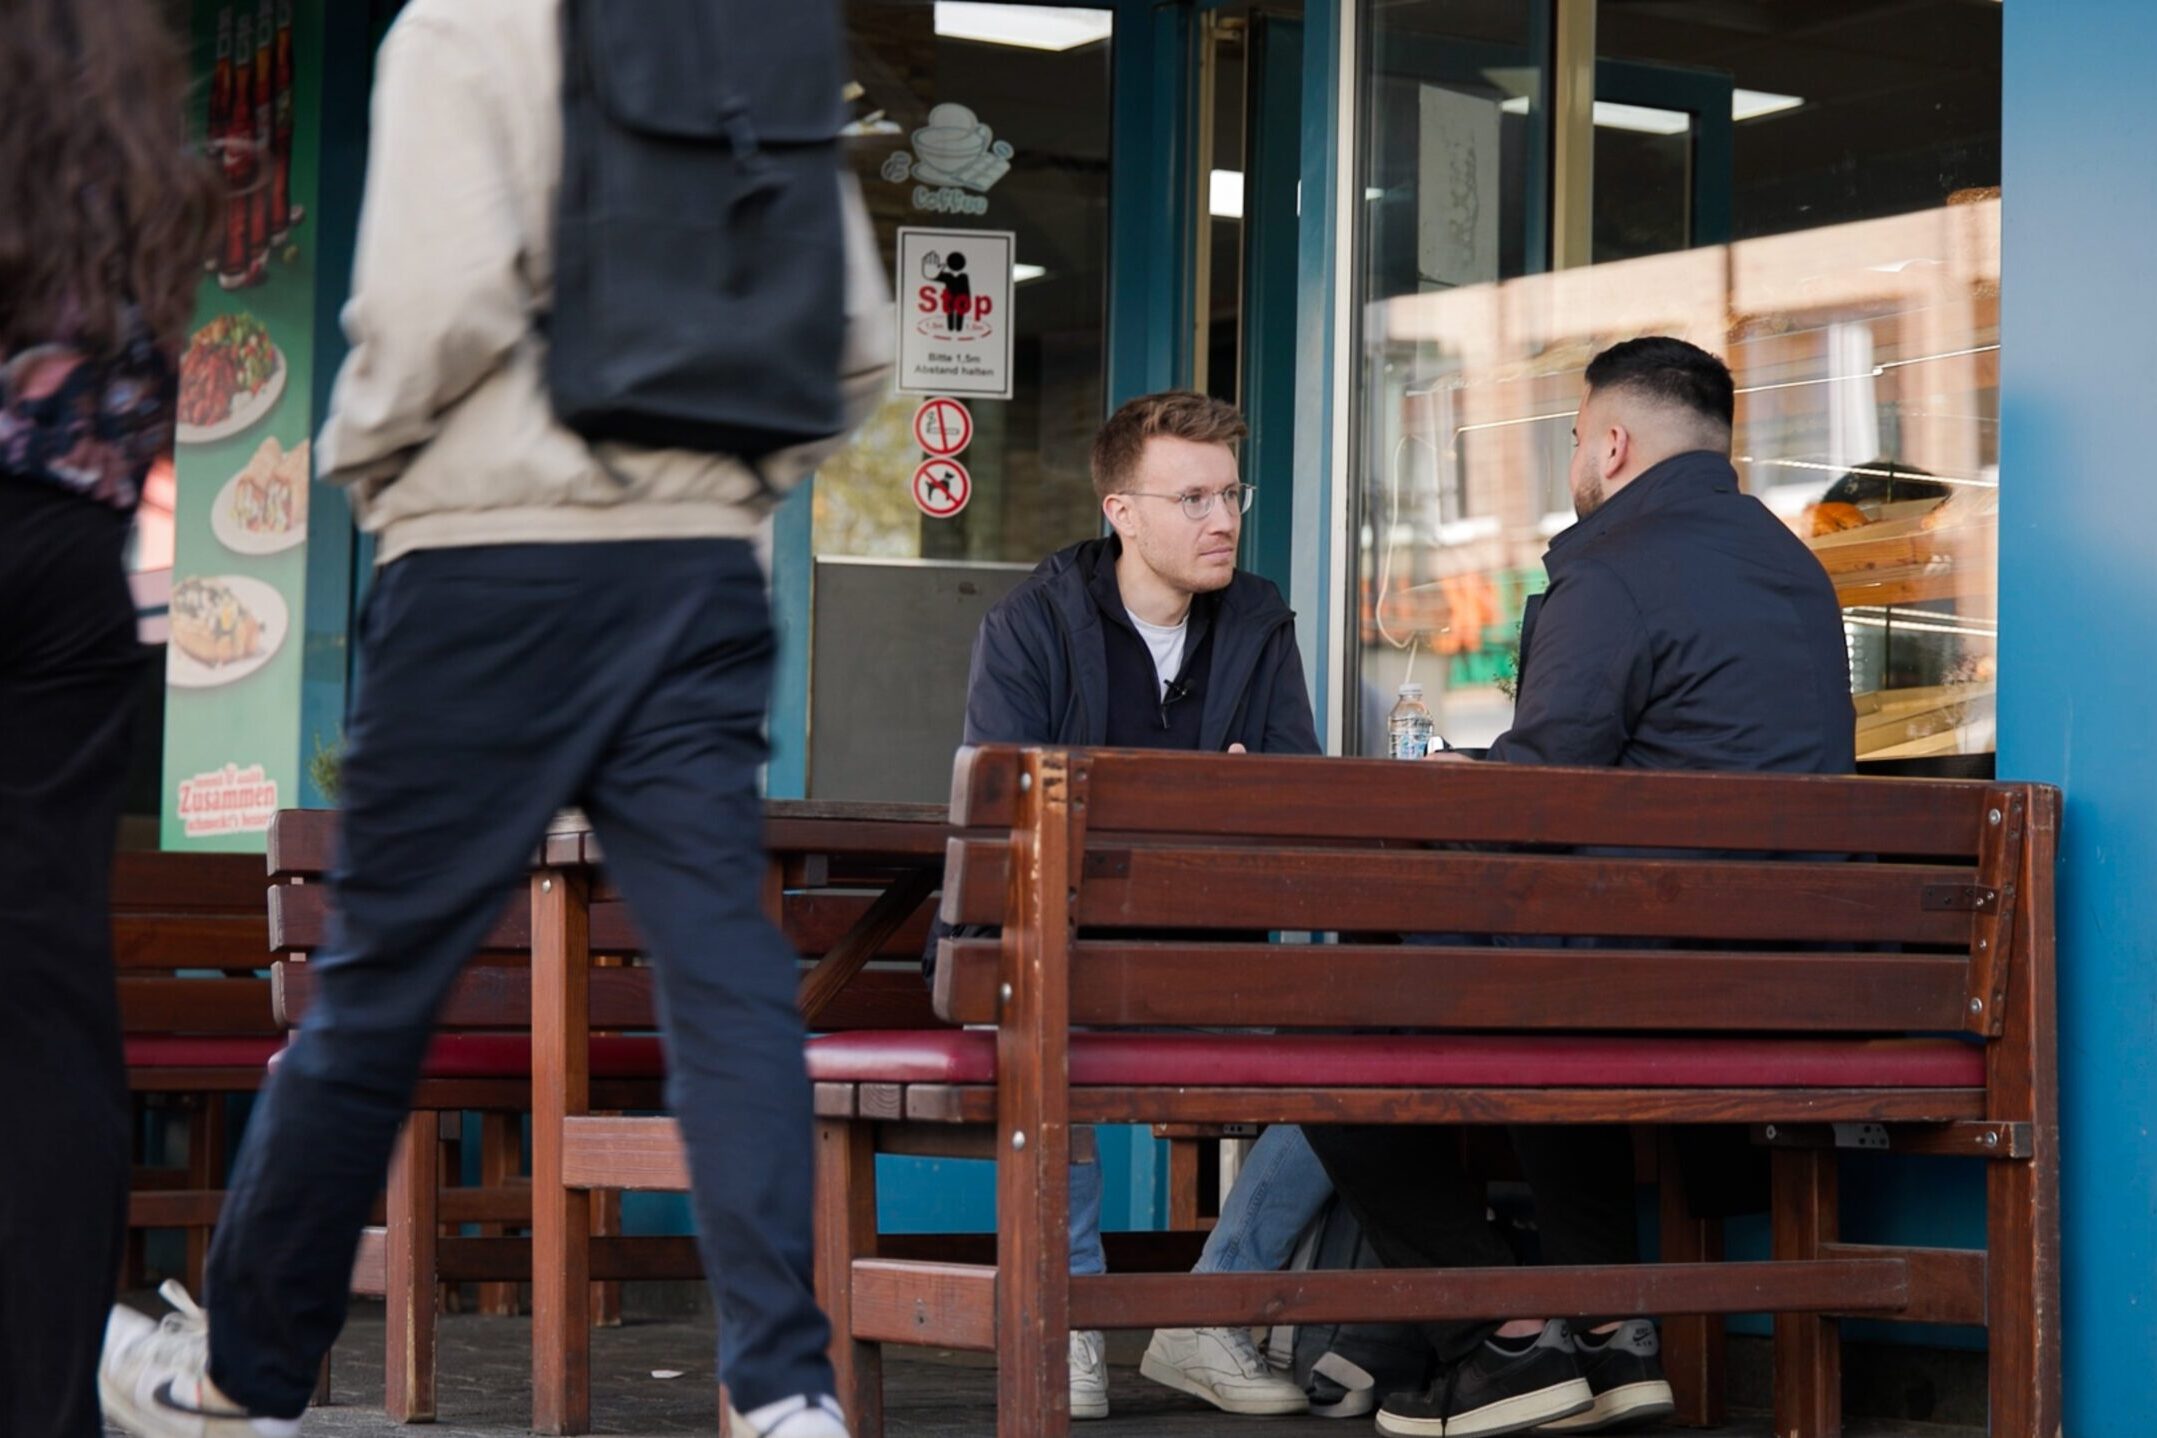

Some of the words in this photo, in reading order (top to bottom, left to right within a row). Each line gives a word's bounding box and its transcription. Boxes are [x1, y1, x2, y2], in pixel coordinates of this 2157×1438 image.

[913, 186, 987, 215] Coffee
[918, 285, 993, 322] Stop
[914, 364, 959, 375] Abstand
[961, 366, 994, 376] halten
[928, 352, 952, 362] Bitte
[956, 353, 981, 363] 1,5m
[180, 785, 275, 813] Zusammen
